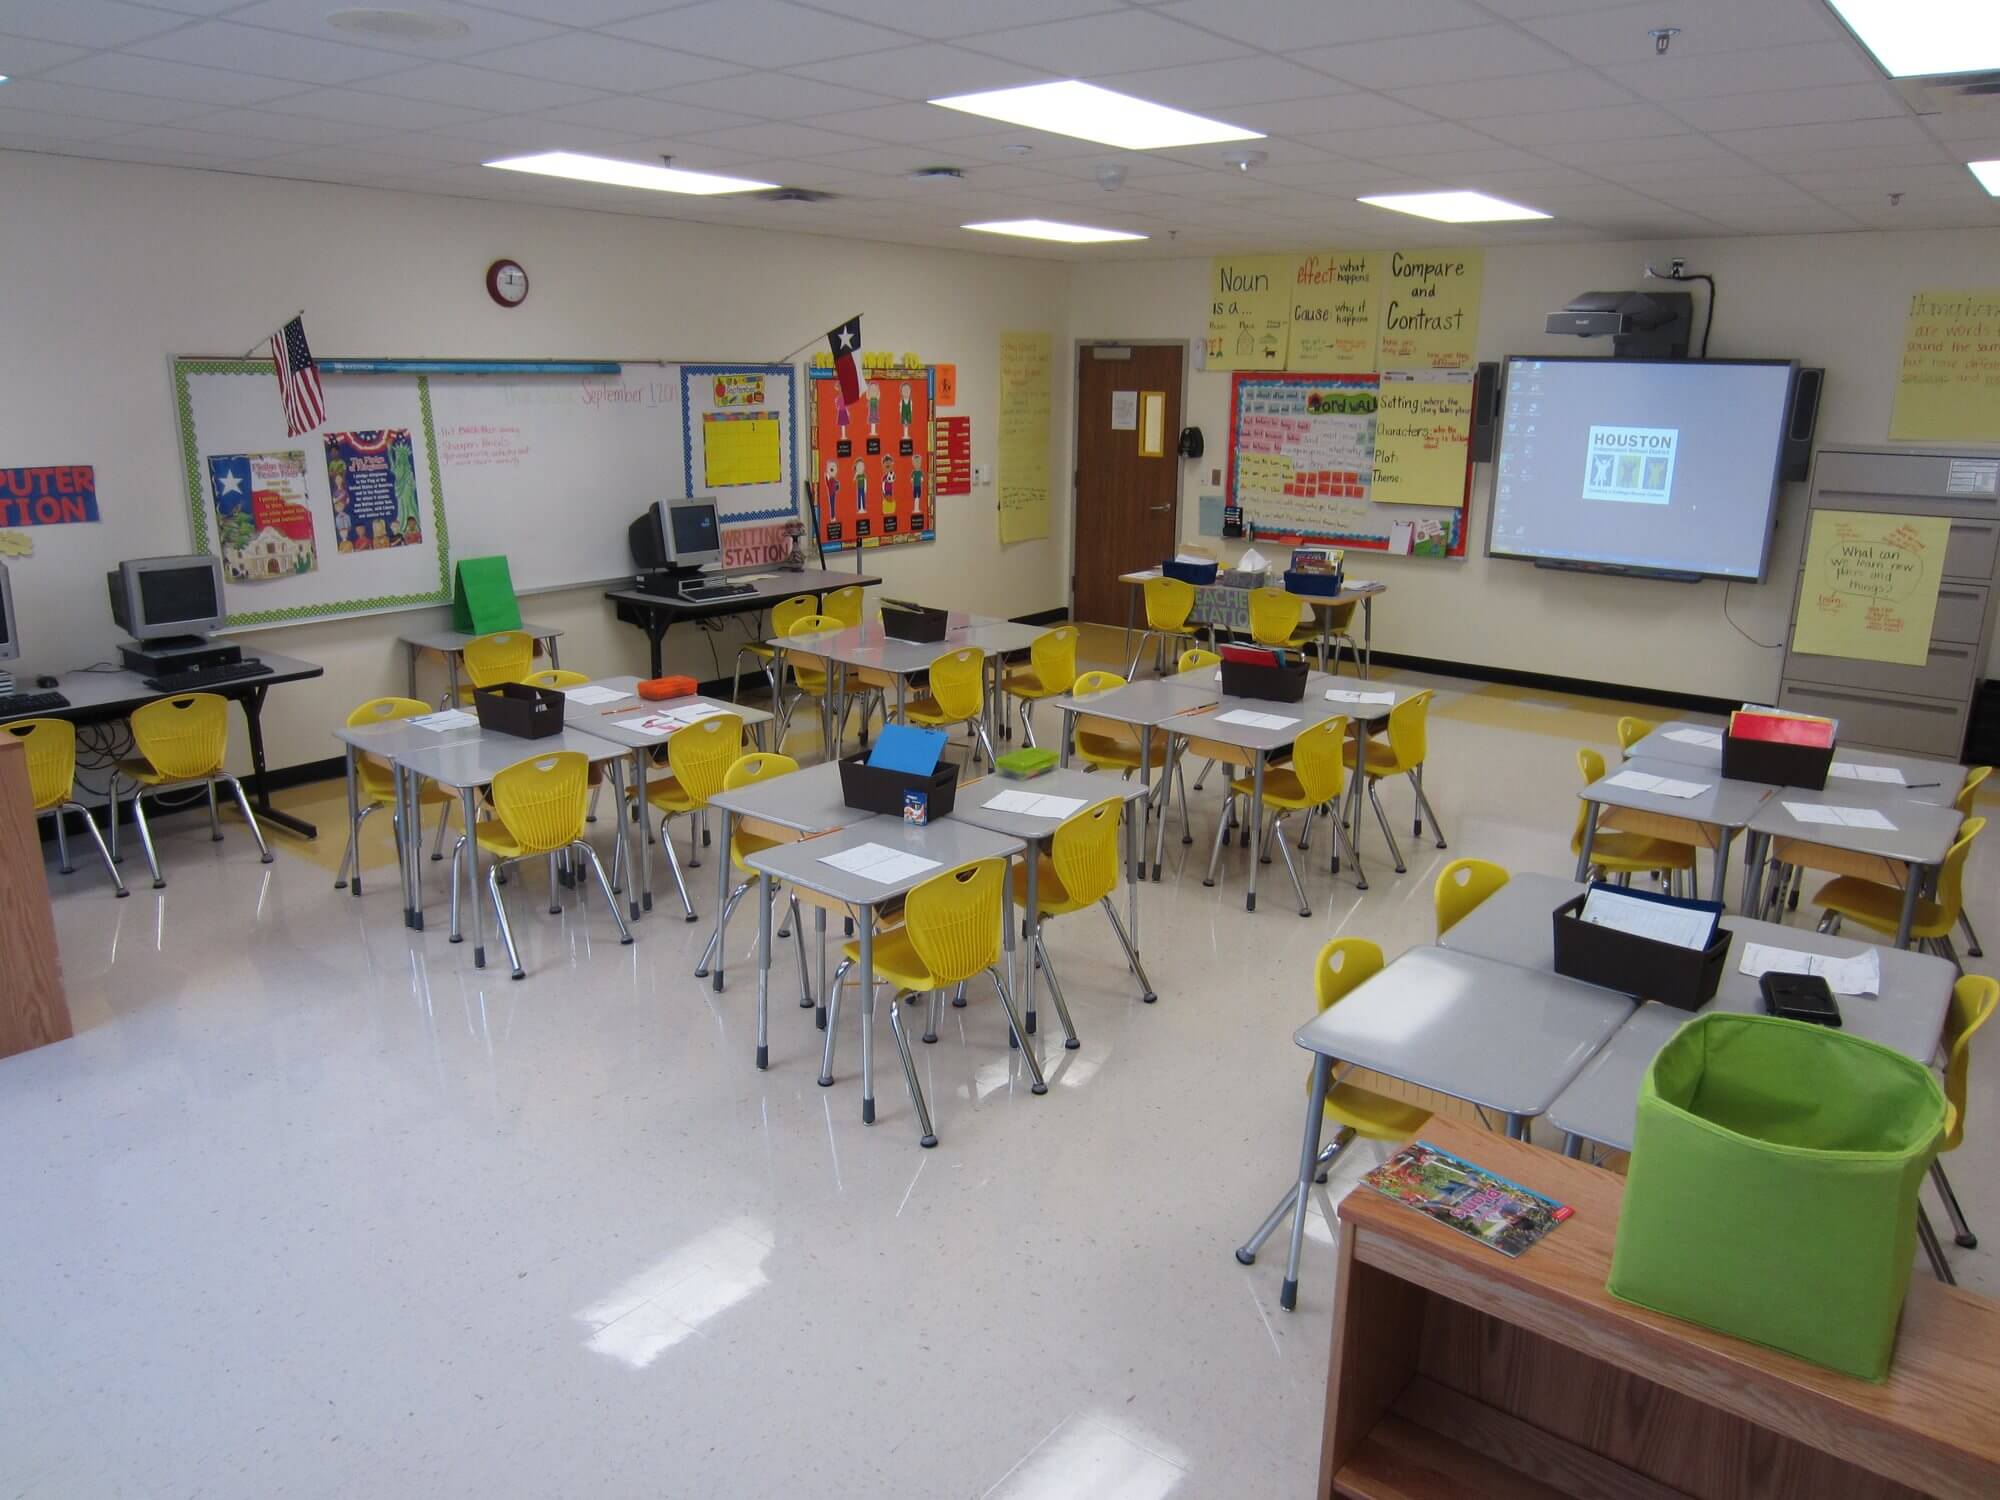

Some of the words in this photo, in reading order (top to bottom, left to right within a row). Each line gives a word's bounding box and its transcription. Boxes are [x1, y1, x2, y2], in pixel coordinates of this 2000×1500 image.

[1297, 256, 1336, 285] effect
[1339, 259, 1366, 273] what
[1392, 252, 1464, 284] Compare
[1220, 267, 1269, 293] Noun
[1411, 285, 1436, 297] and
[1335, 304, 1355, 316] why
[1387, 301, 1464, 331] Contrast
[582, 379, 644, 410] September
[1594, 433, 1672, 448] HOUSTON
[723, 525, 786, 547] WRITING
[725, 544, 789, 566] STATION
[1842, 546, 1874, 559] What
[1197, 591, 1248, 608] EACHE
